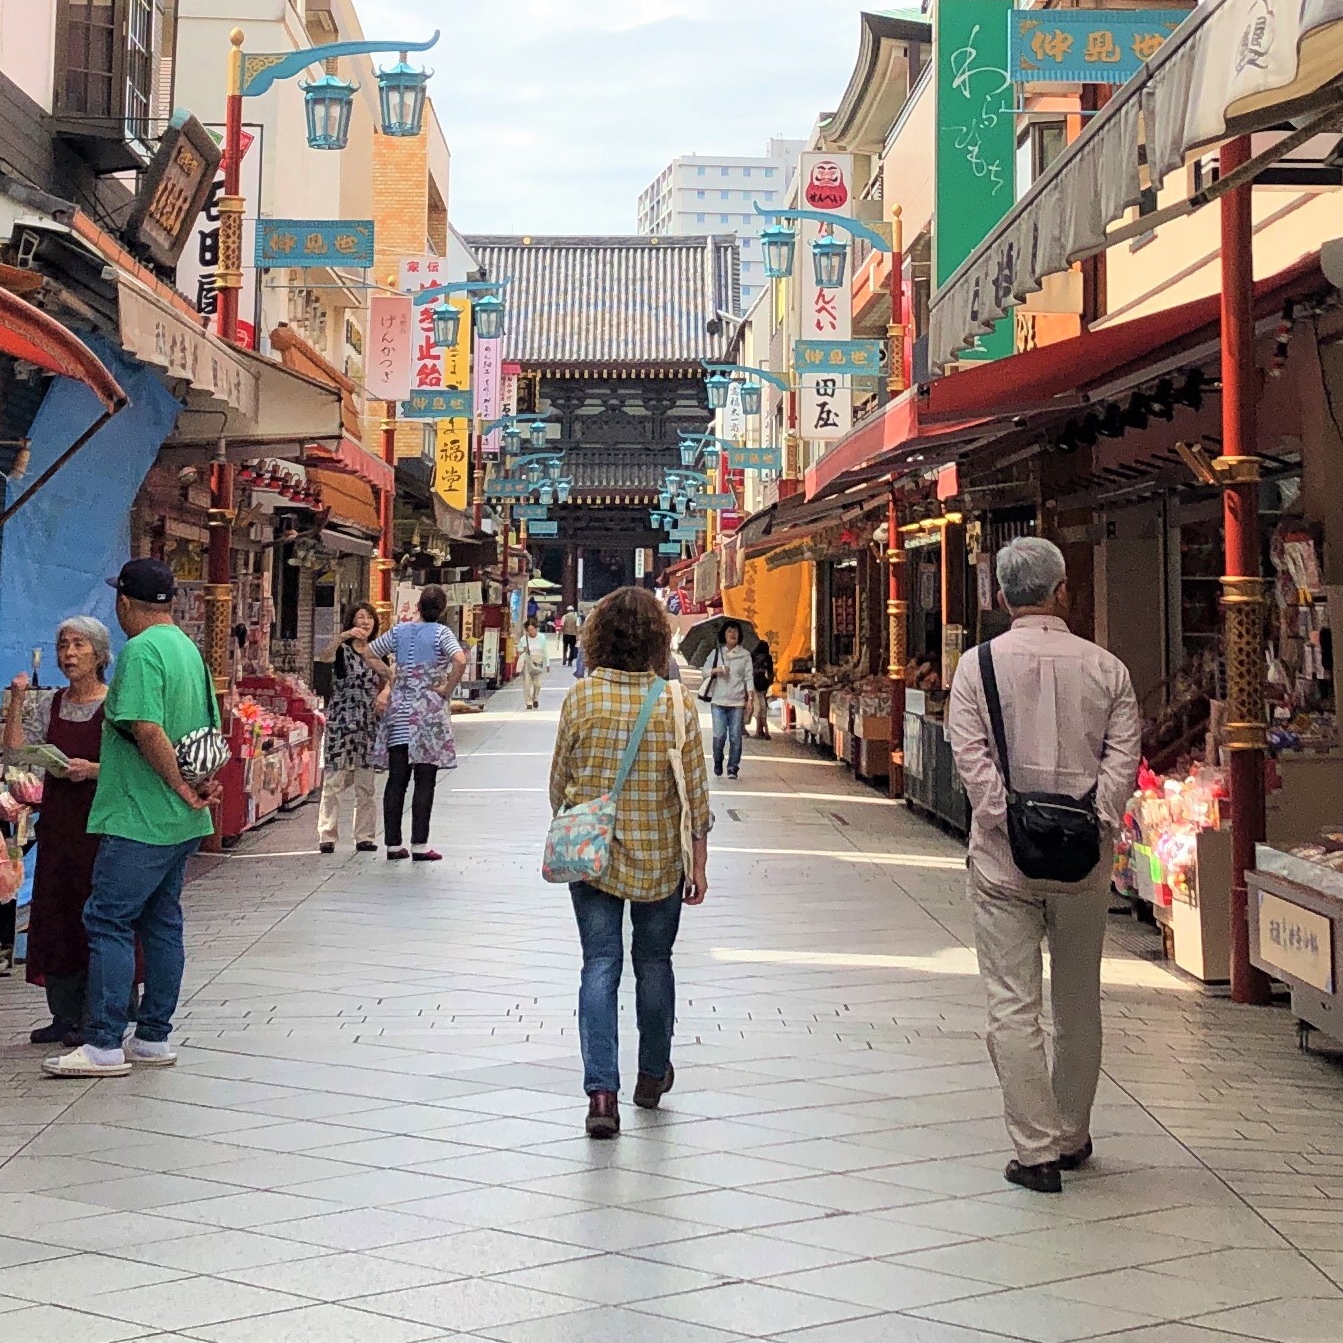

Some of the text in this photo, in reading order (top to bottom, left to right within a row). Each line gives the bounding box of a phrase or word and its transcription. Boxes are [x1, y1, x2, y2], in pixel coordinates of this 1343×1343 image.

[1032, 28, 1167, 64] 仲見世
[941, 25, 1012, 196] わらびもち
[407, 260, 439, 273] 家伝
[379, 314, 396, 384] げんかつぎ
[815, 378, 839, 430] 田屋
